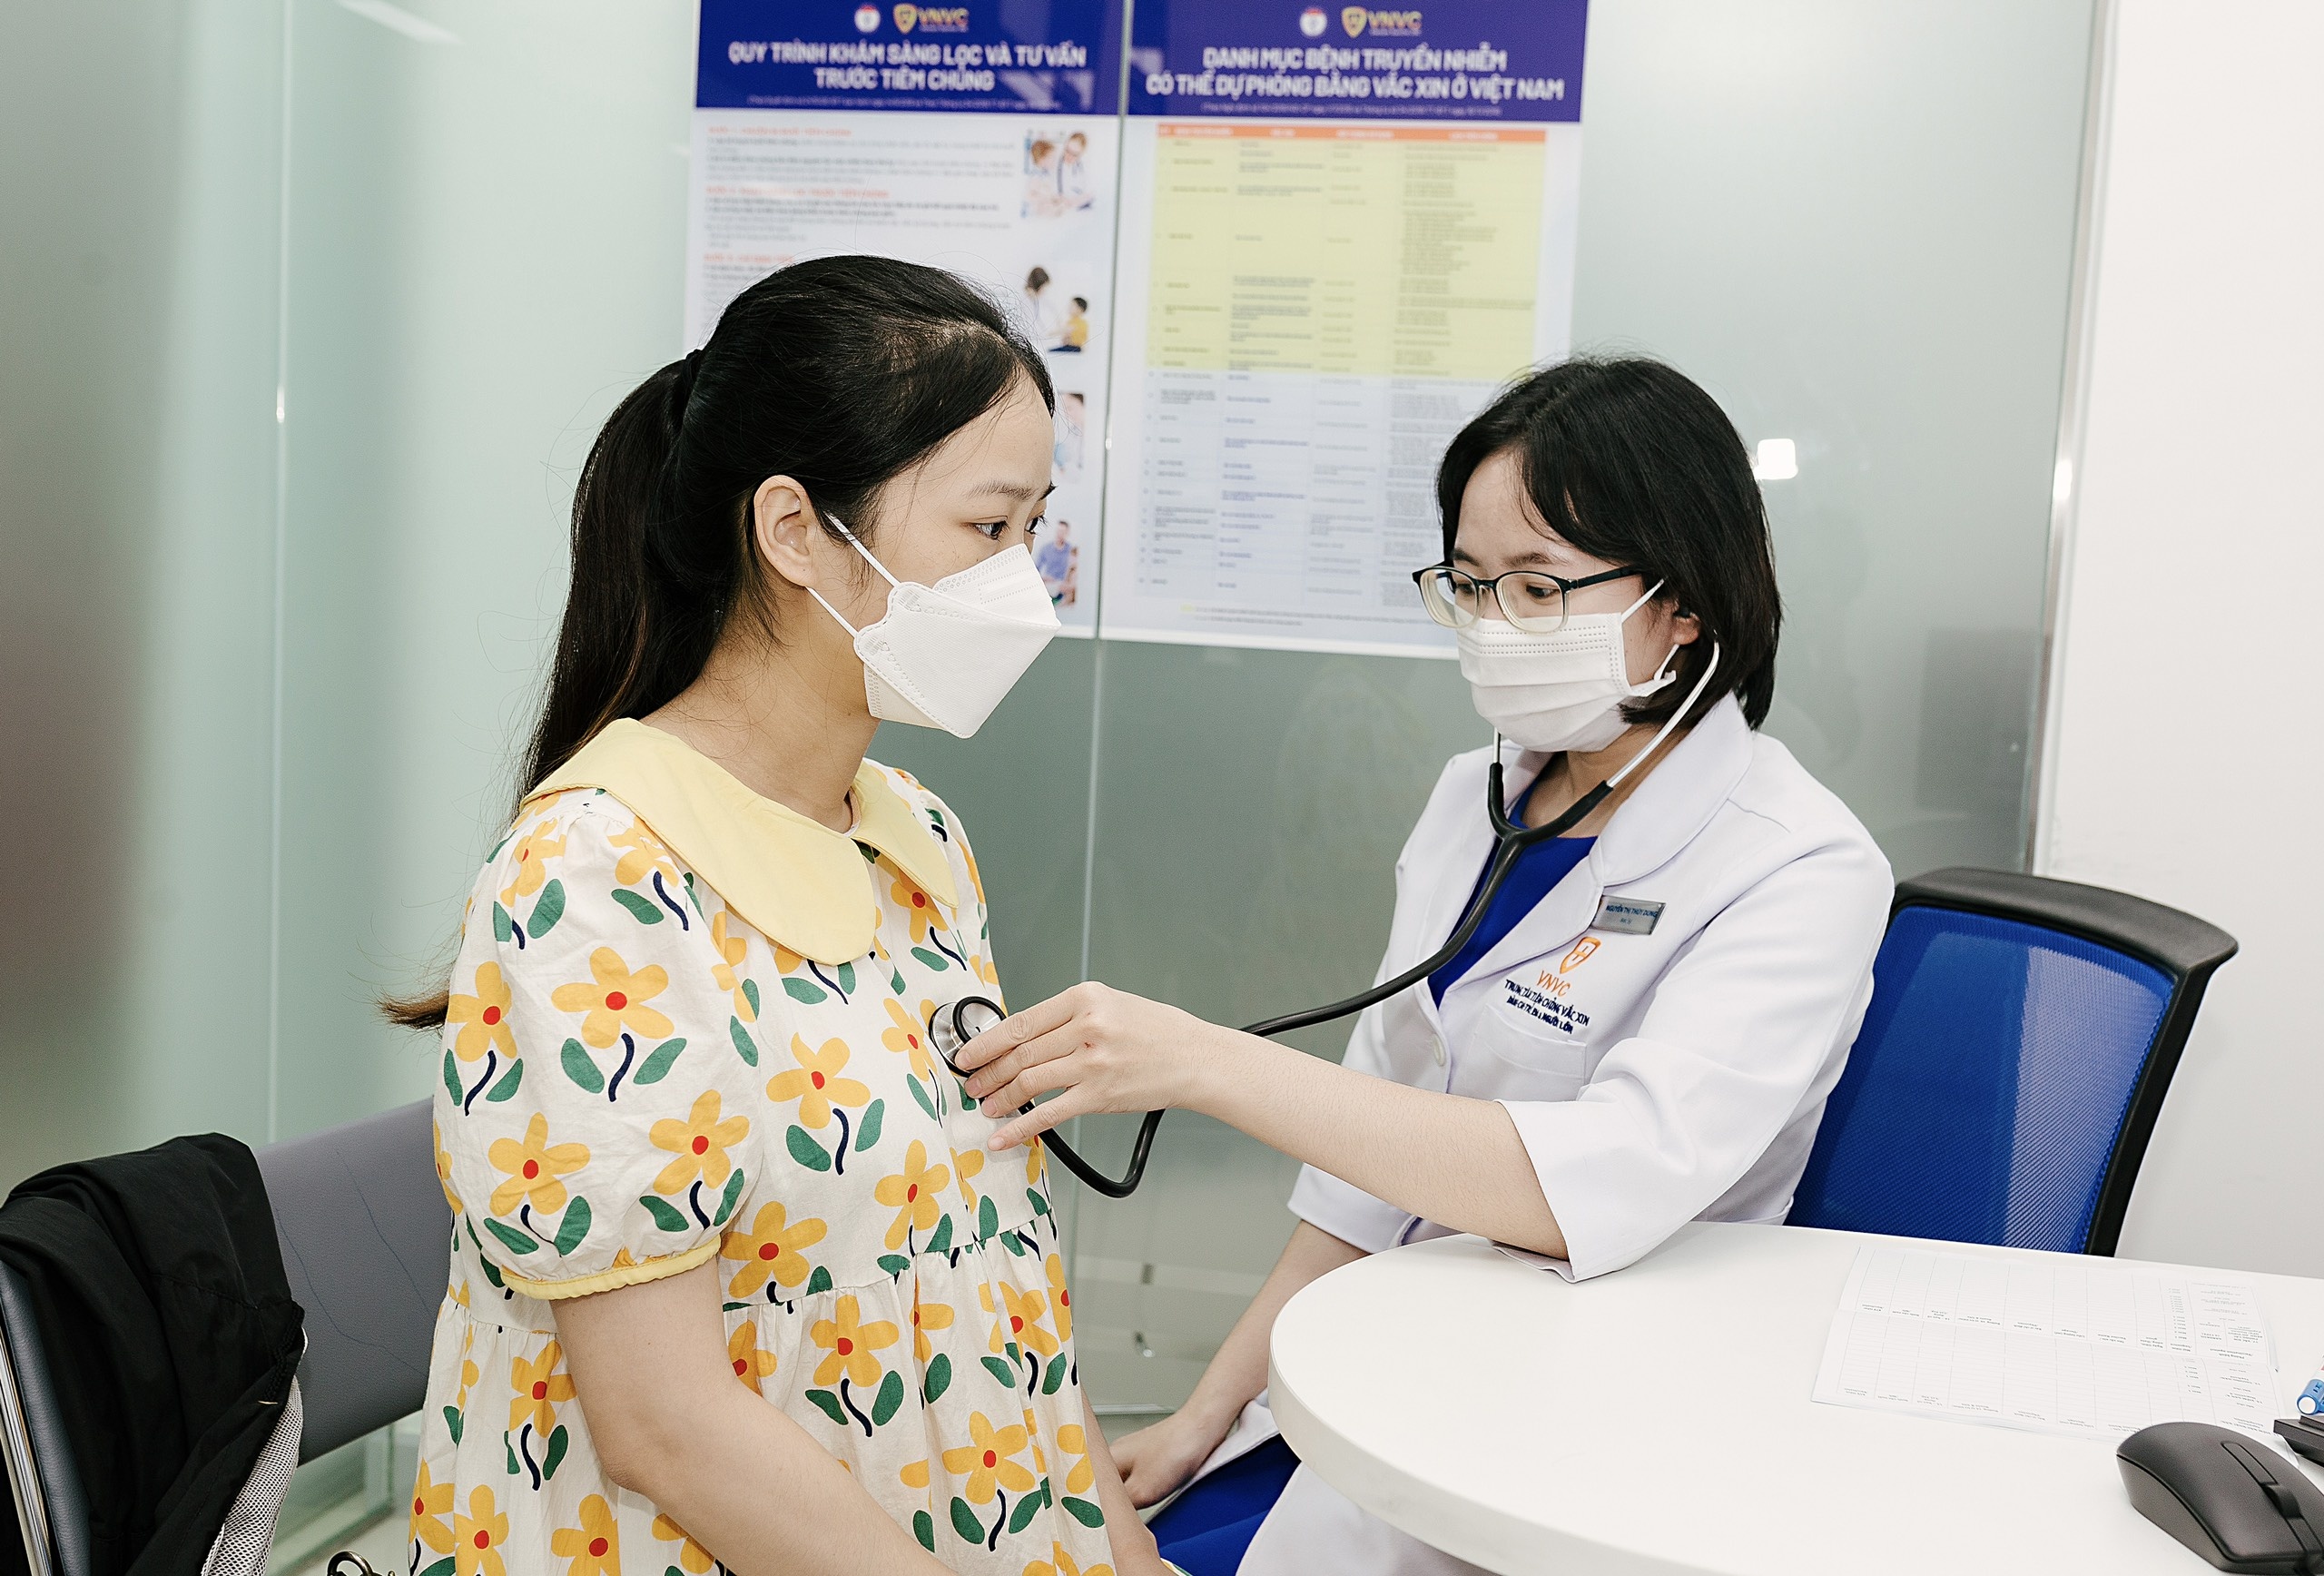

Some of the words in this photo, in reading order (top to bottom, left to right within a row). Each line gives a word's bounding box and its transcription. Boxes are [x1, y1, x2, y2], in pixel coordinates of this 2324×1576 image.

[917, 7, 969, 26] VNVC
[1367, 10, 1422, 30] VNVC
[728, 41, 768, 65] QUY
[770, 37, 827, 64] TRÌNH
[829, 39, 885, 64] KHÁM
[942, 44, 983, 68] LỌC
[984, 40, 1013, 66] VÀ
[1203, 46, 1259, 69] DANH
[1260, 47, 1304, 74] MỤC
[1305, 44, 1361, 74] BỆNH
[1146, 70, 1174, 95] CÓ
[1414, 76, 1451, 99] XIN
[1469, 73, 1516, 104] VIỆT
[1517, 78, 1565, 101] NAM
[1537, 970, 1571, 997] VNVC
